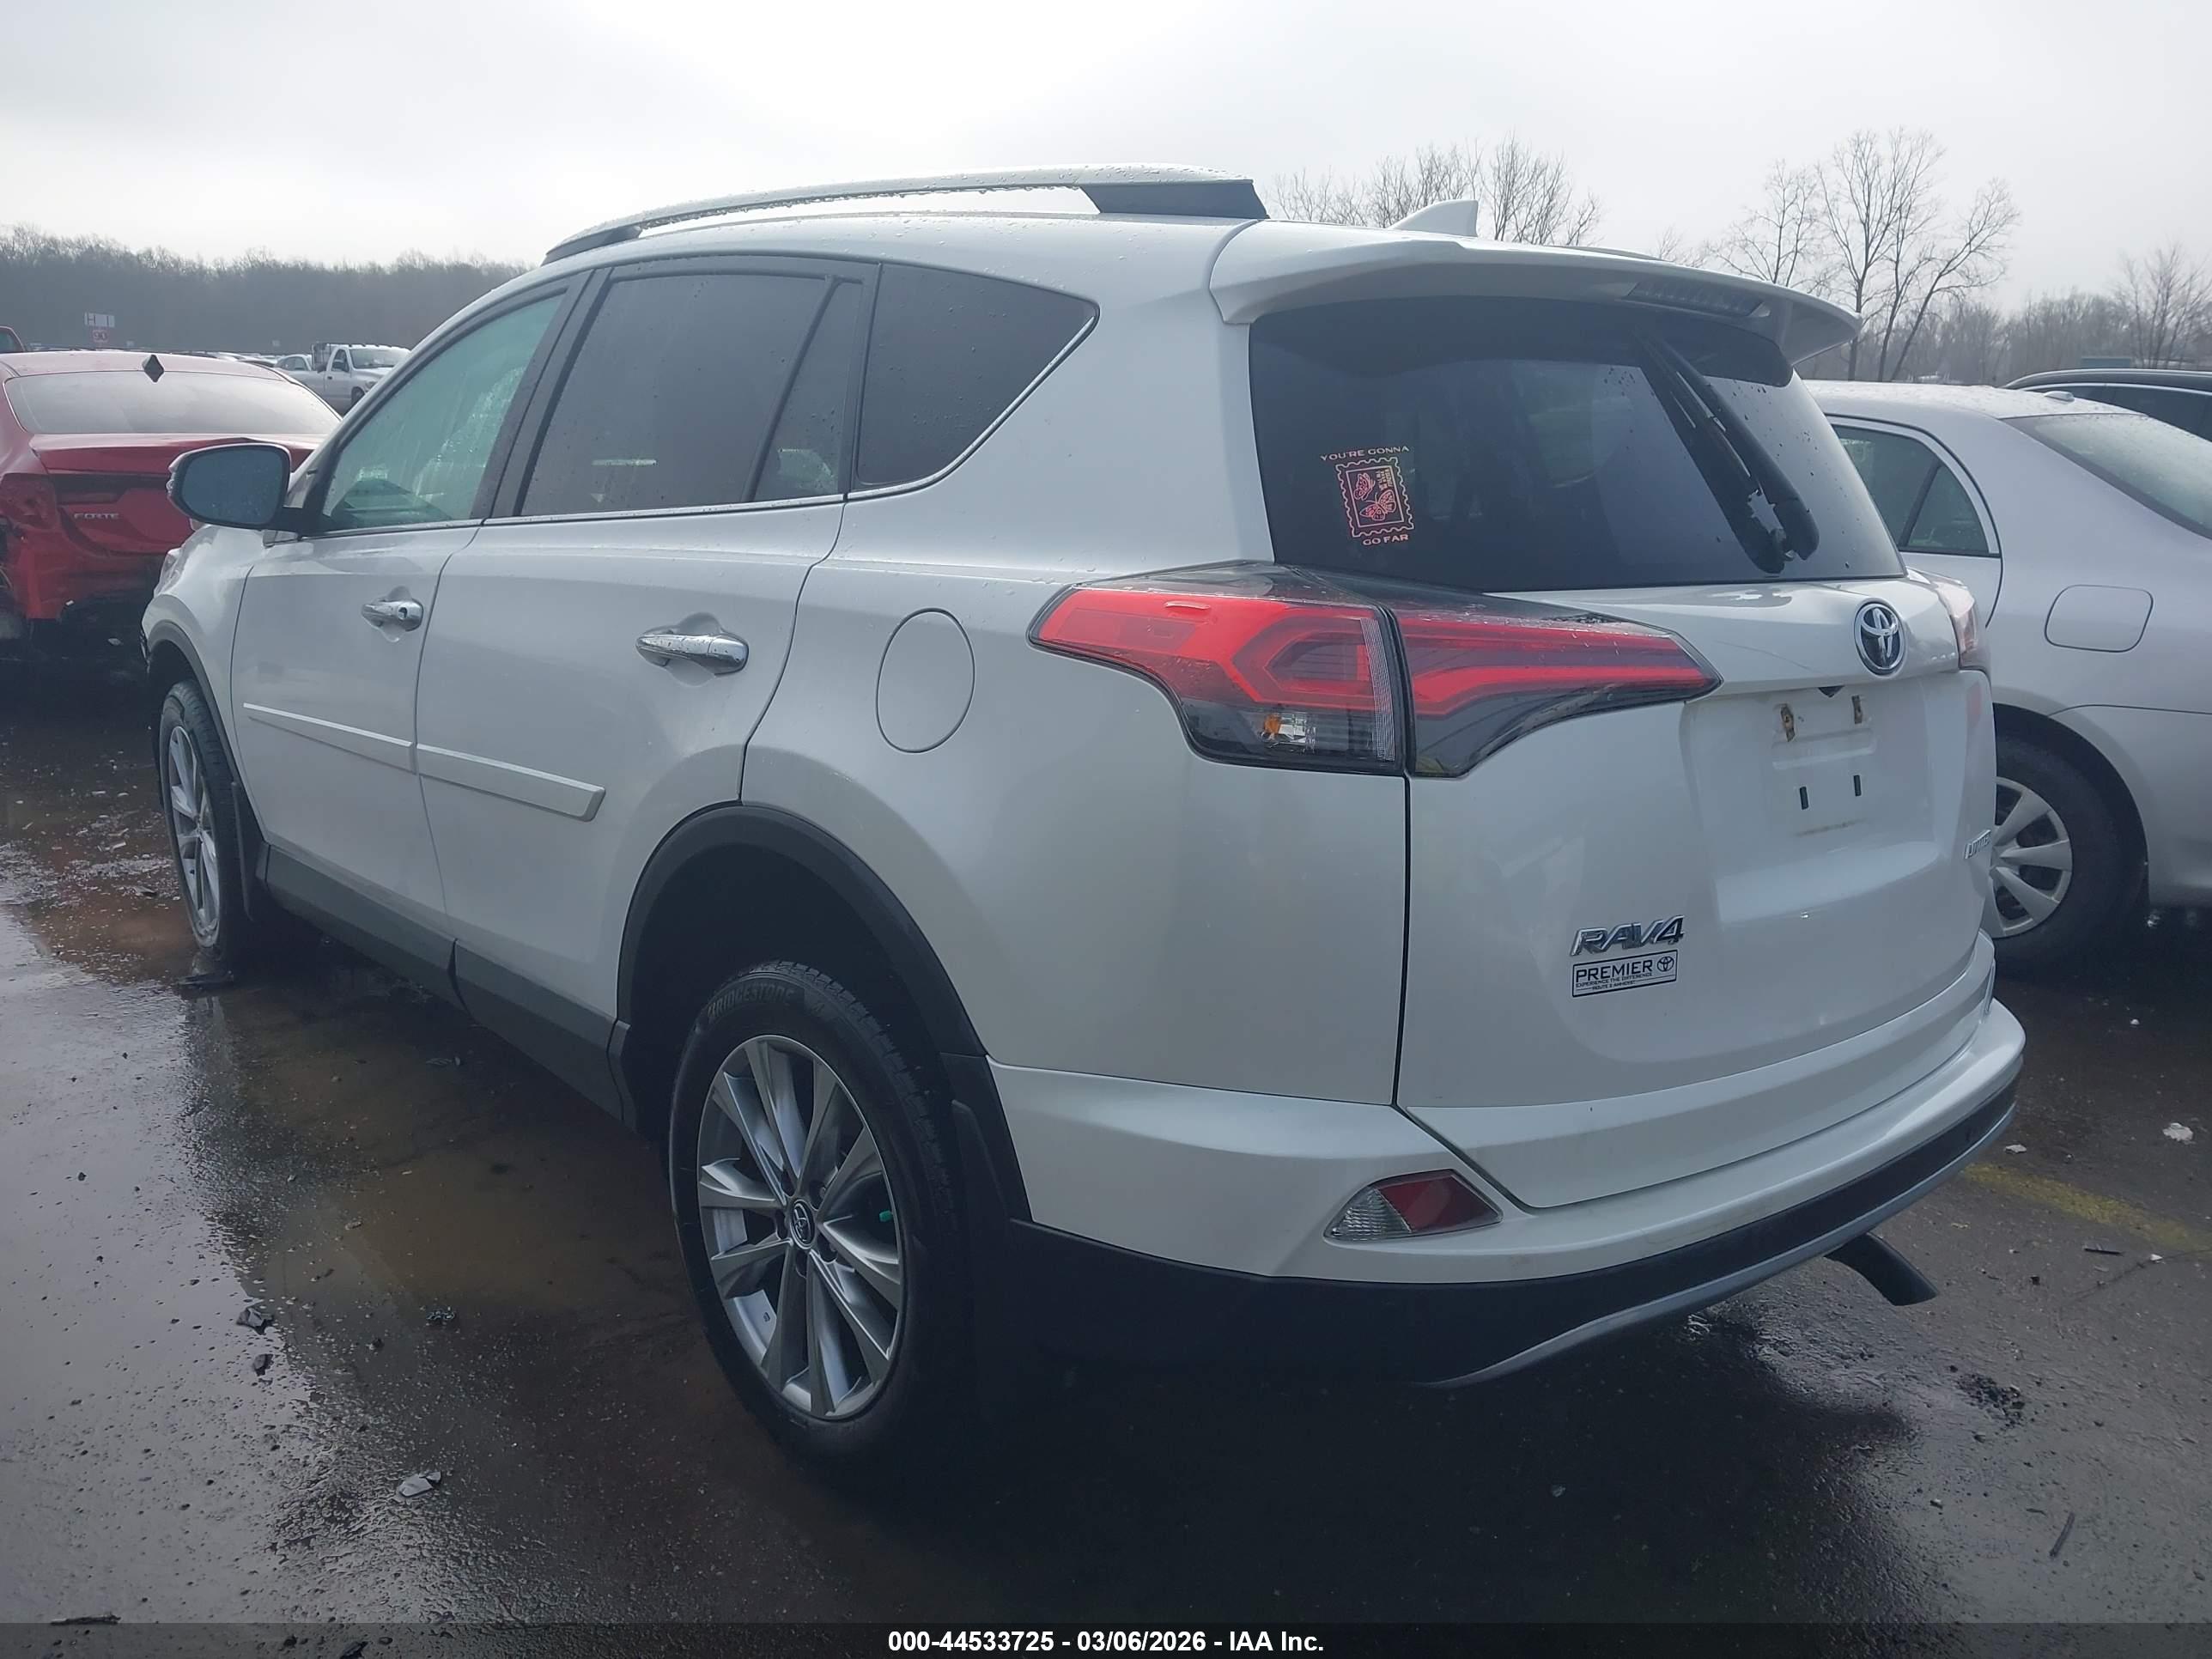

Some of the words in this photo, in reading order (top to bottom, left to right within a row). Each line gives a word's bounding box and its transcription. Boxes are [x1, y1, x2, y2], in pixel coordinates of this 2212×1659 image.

[1321, 449, 1365, 461] YOU'RE
[1368, 446, 1410, 455] GONNA
[1363, 538, 1381, 546] GO
[1383, 533, 1409, 544] FAR
[1571, 915, 1685, 957] RAV4
[1576, 959, 1653, 982] PREMIER
